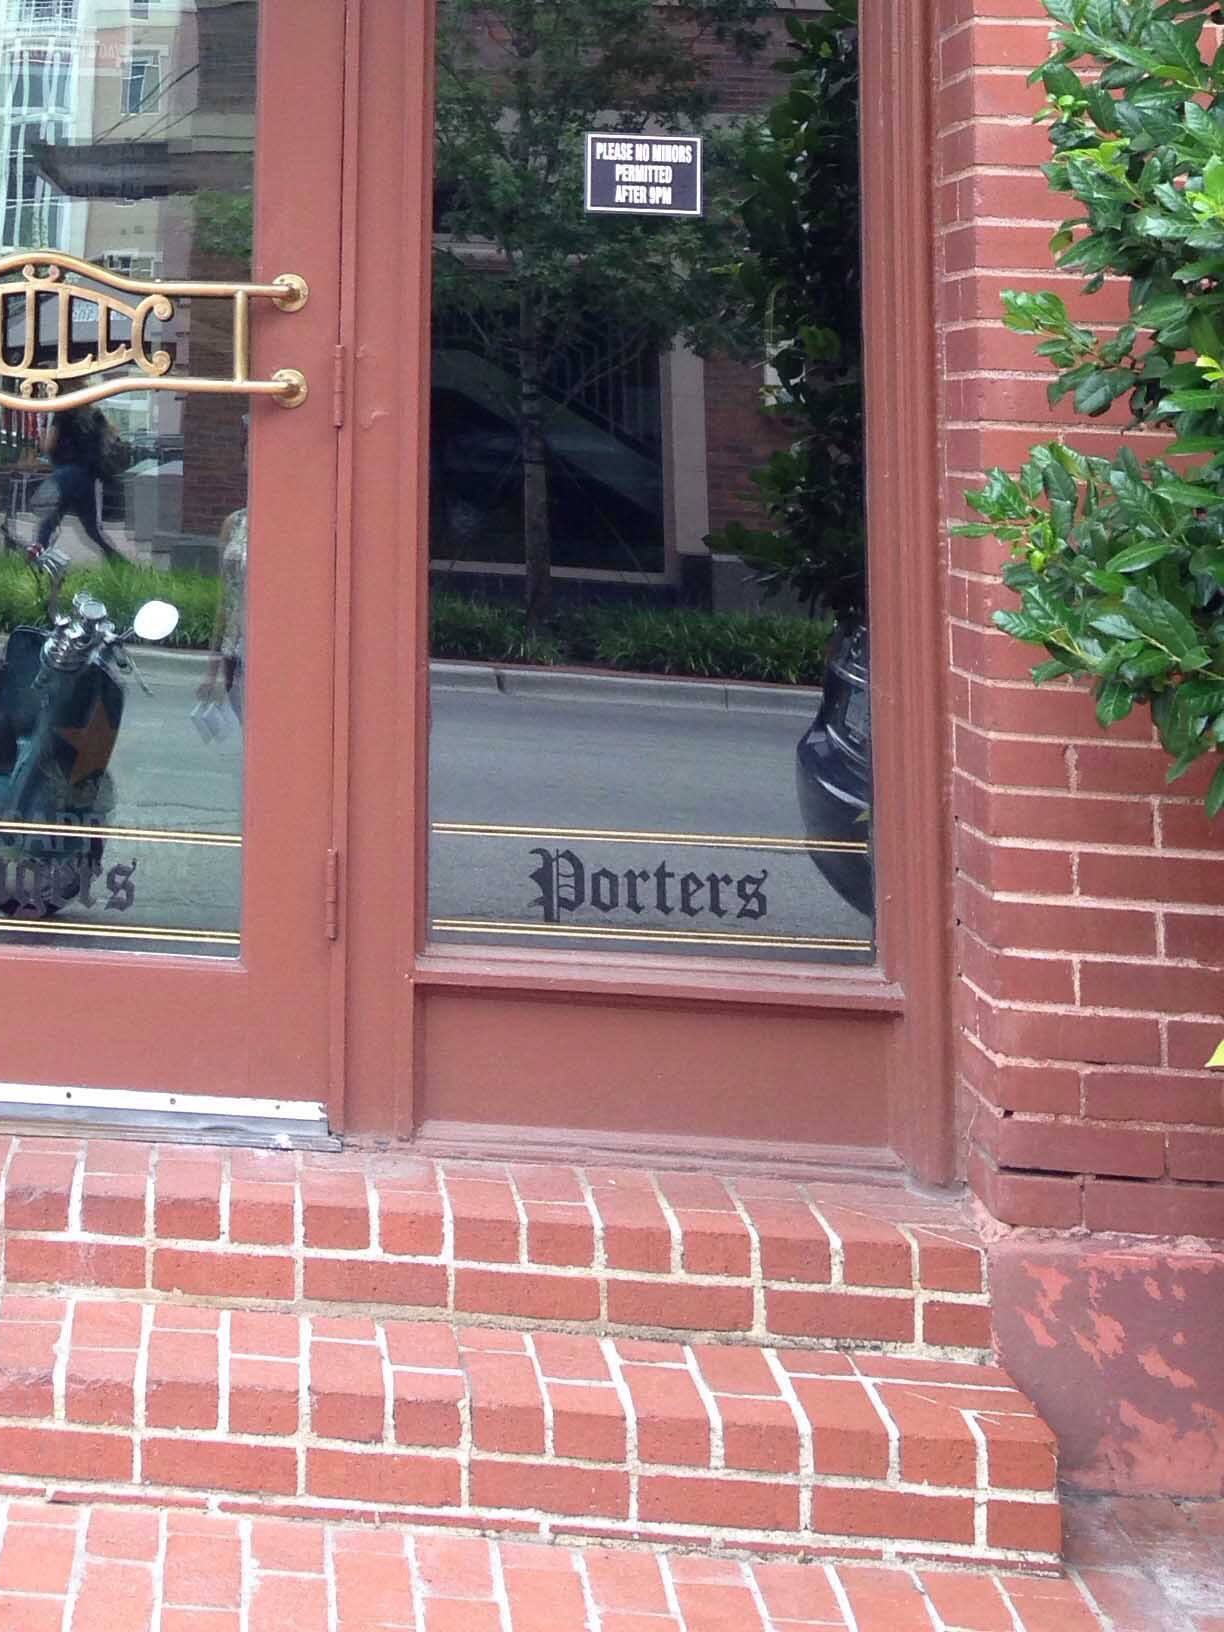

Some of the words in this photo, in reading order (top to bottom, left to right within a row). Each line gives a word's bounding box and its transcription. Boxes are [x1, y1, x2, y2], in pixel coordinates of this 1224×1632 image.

[595, 142, 634, 161] PLEASE
[635, 143, 650, 162] NO
[652, 144, 693, 164] MINORS
[614, 163, 673, 184] PERMITTED
[614, 184, 647, 204] AFTER
[649, 186, 672, 205] 9PM
[528, 847, 769, 923] Porters
